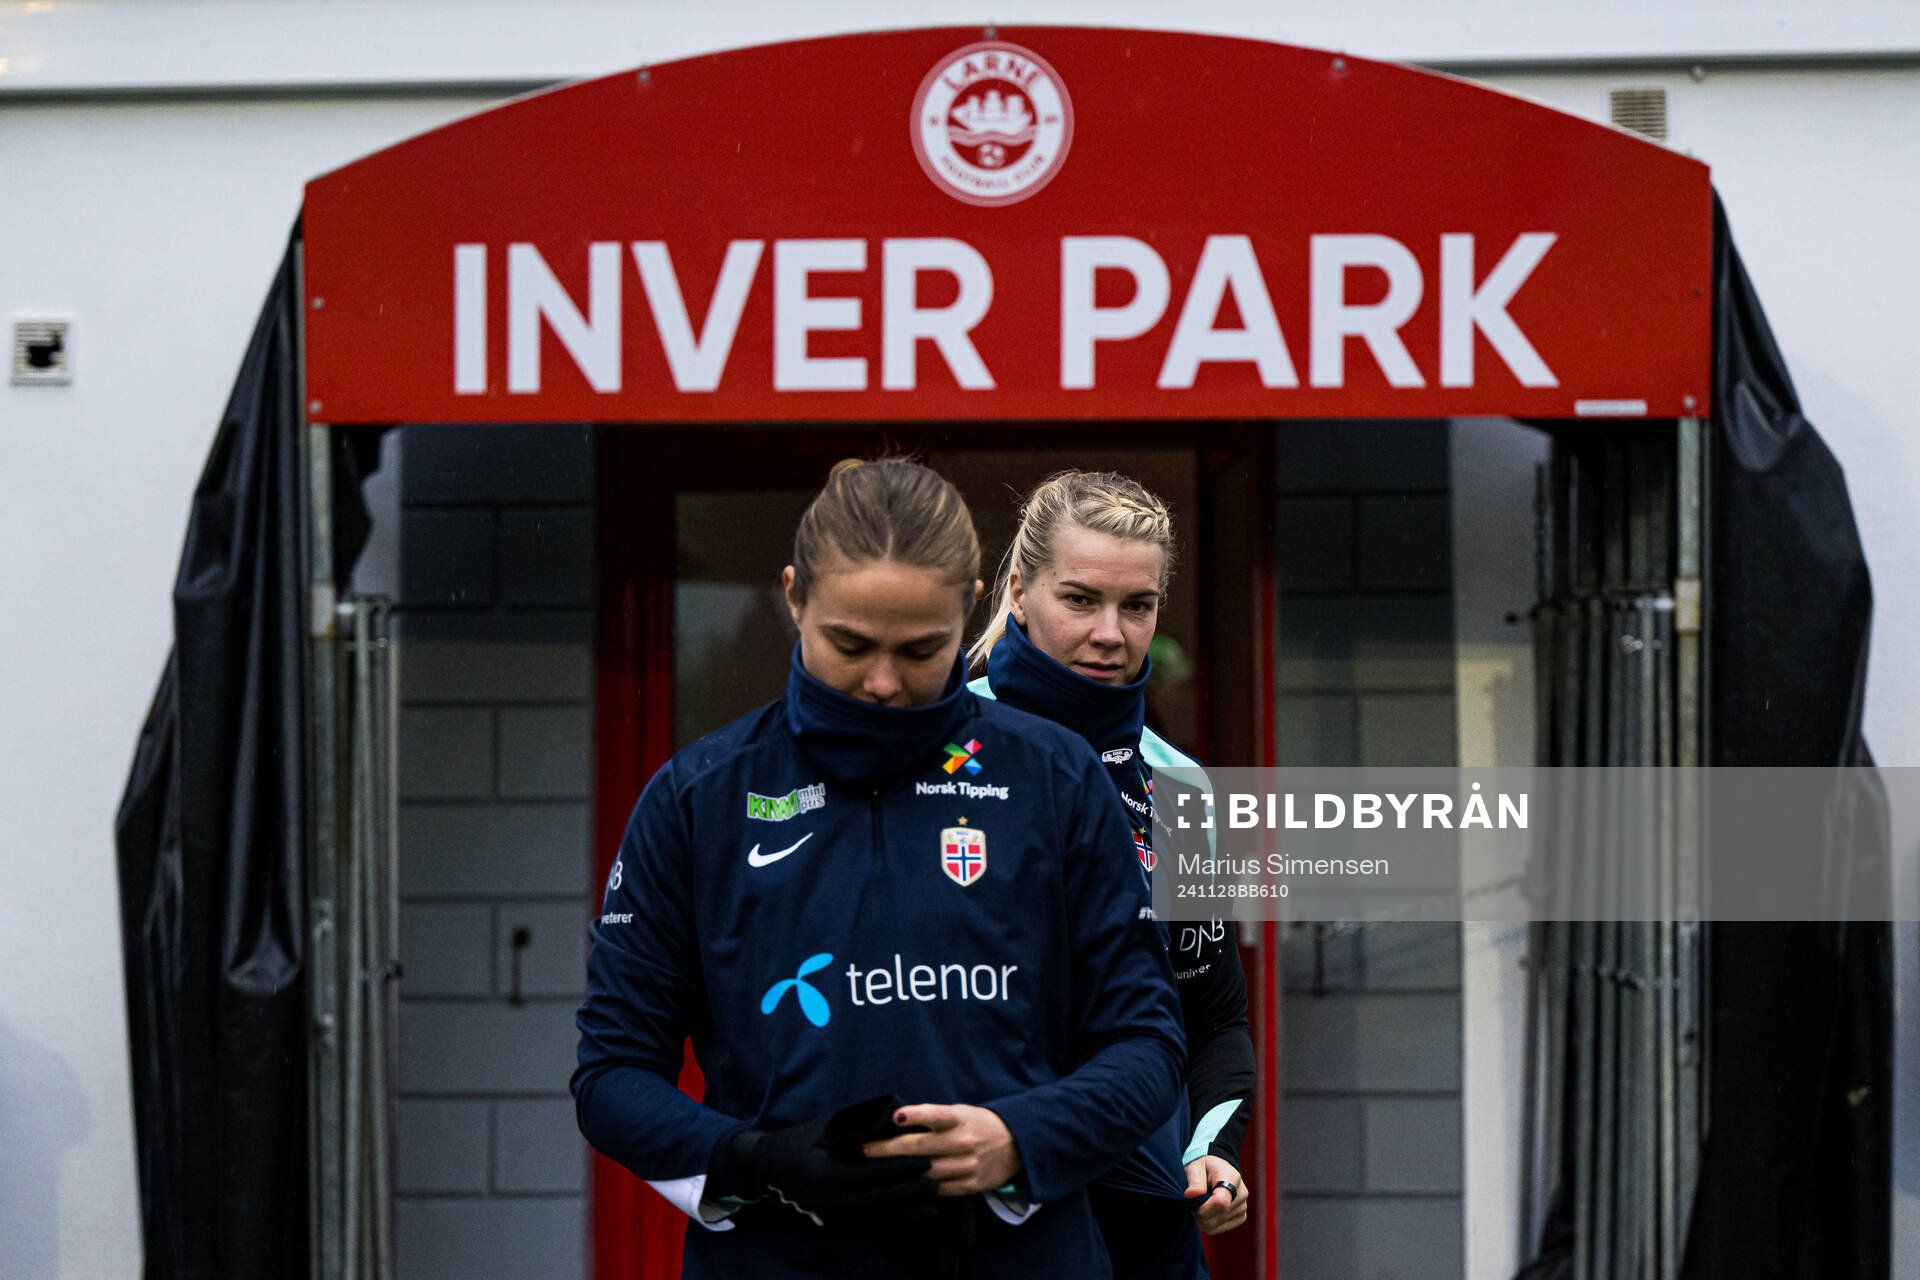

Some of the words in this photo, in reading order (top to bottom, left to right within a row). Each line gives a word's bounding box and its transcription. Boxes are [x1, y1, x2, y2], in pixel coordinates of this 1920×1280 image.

[454, 238, 998, 395] INVER
[1060, 232, 1560, 389] PARK
[748, 791, 799, 821] KIWI
[916, 781, 957, 795] Norsk
[957, 781, 1009, 800] Tipping
[1121, 791, 1149, 815] Norsk
[1180, 914, 1225, 959] DNB
[846, 953, 1018, 1006] telenor
